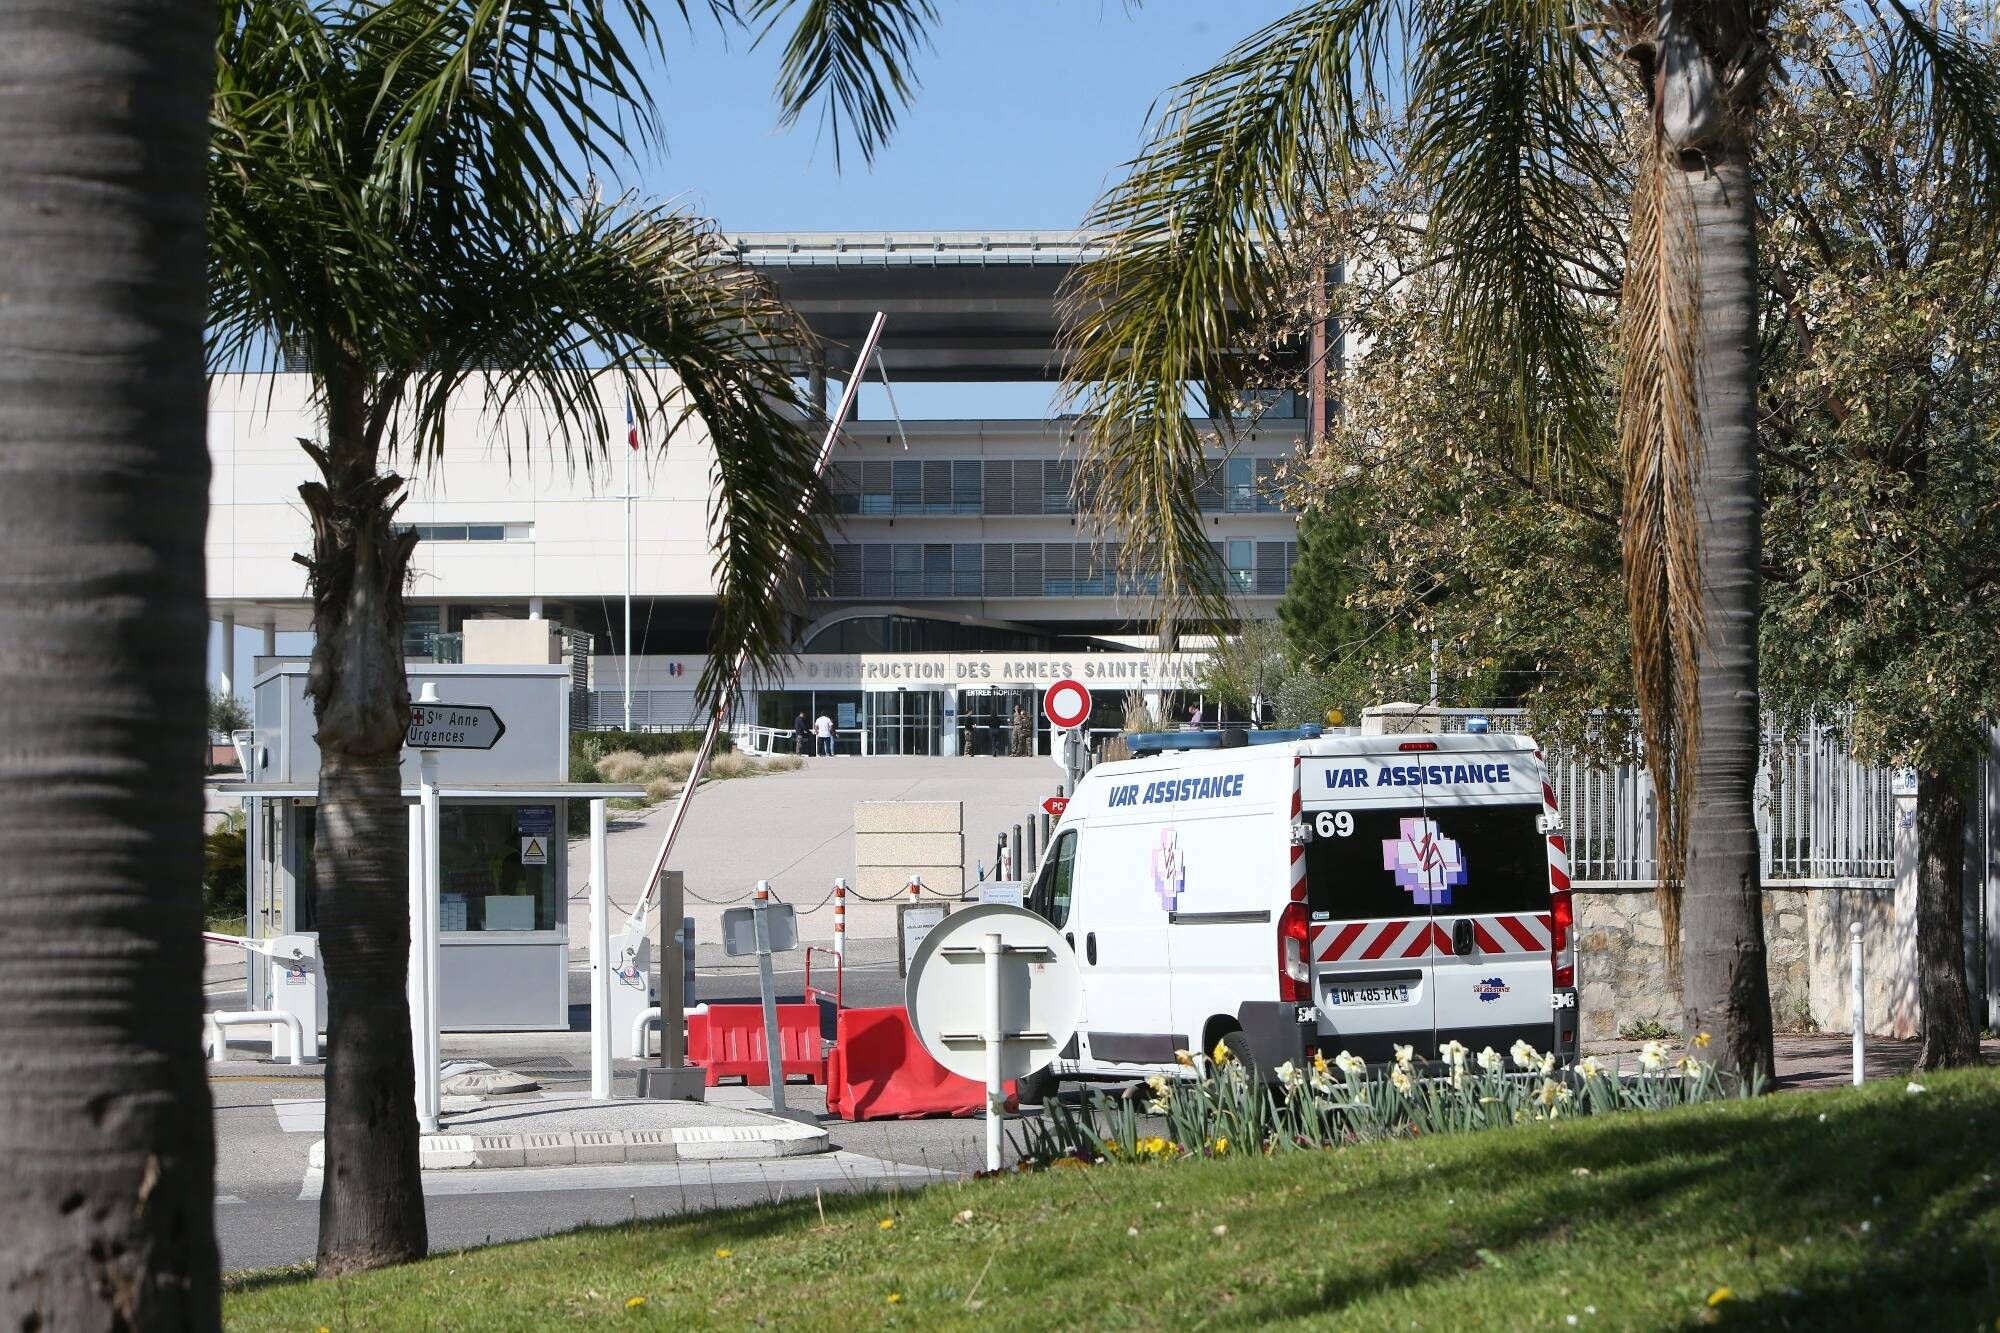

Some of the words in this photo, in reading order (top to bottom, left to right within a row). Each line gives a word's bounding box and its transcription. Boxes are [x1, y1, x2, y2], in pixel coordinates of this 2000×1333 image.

[957, 662, 990, 678] DES
[1003, 661, 1073, 678] ARMEES
[1085, 661, 1149, 678] SAINTE
[427, 711, 442, 724] Ste
[449, 712, 479, 726] Anne
[410, 727, 465, 744] Urgences
[1325, 768, 1370, 788] VAR
[1377, 764, 1510, 787] ASSISTANCE
[1108, 784, 1139, 808] VAR
[1142, 774, 1244, 804] ASSISTANCE
[1052, 802, 1063, 810] PC
[1315, 811, 1354, 838] 69
